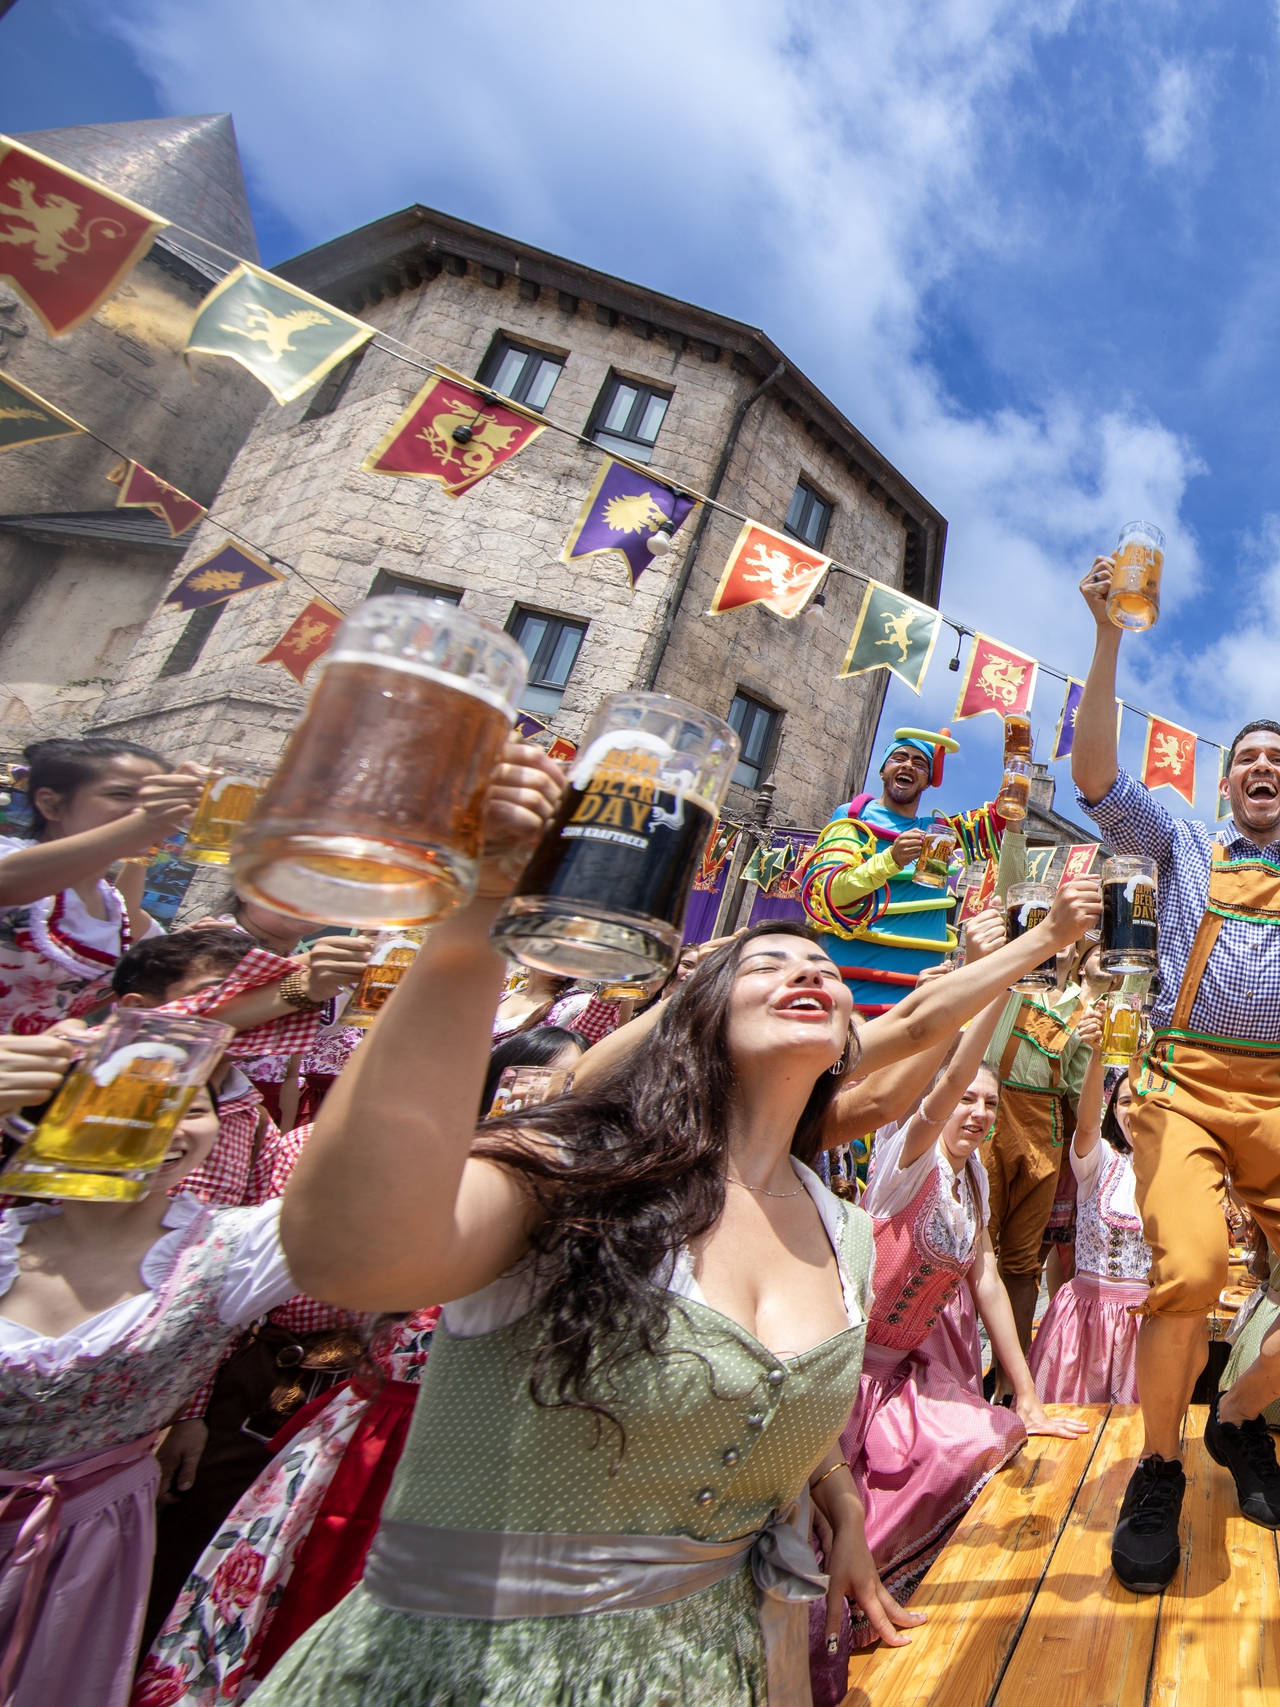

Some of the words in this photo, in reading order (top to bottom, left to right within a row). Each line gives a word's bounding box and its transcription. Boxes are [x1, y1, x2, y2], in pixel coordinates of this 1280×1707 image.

[585, 769, 655, 805] BEER
[569, 794, 653, 833] DAY
[1134, 893, 1155, 907] BEER
[1132, 904, 1155, 920] DAY
[1027, 917, 1043, 929] BE
